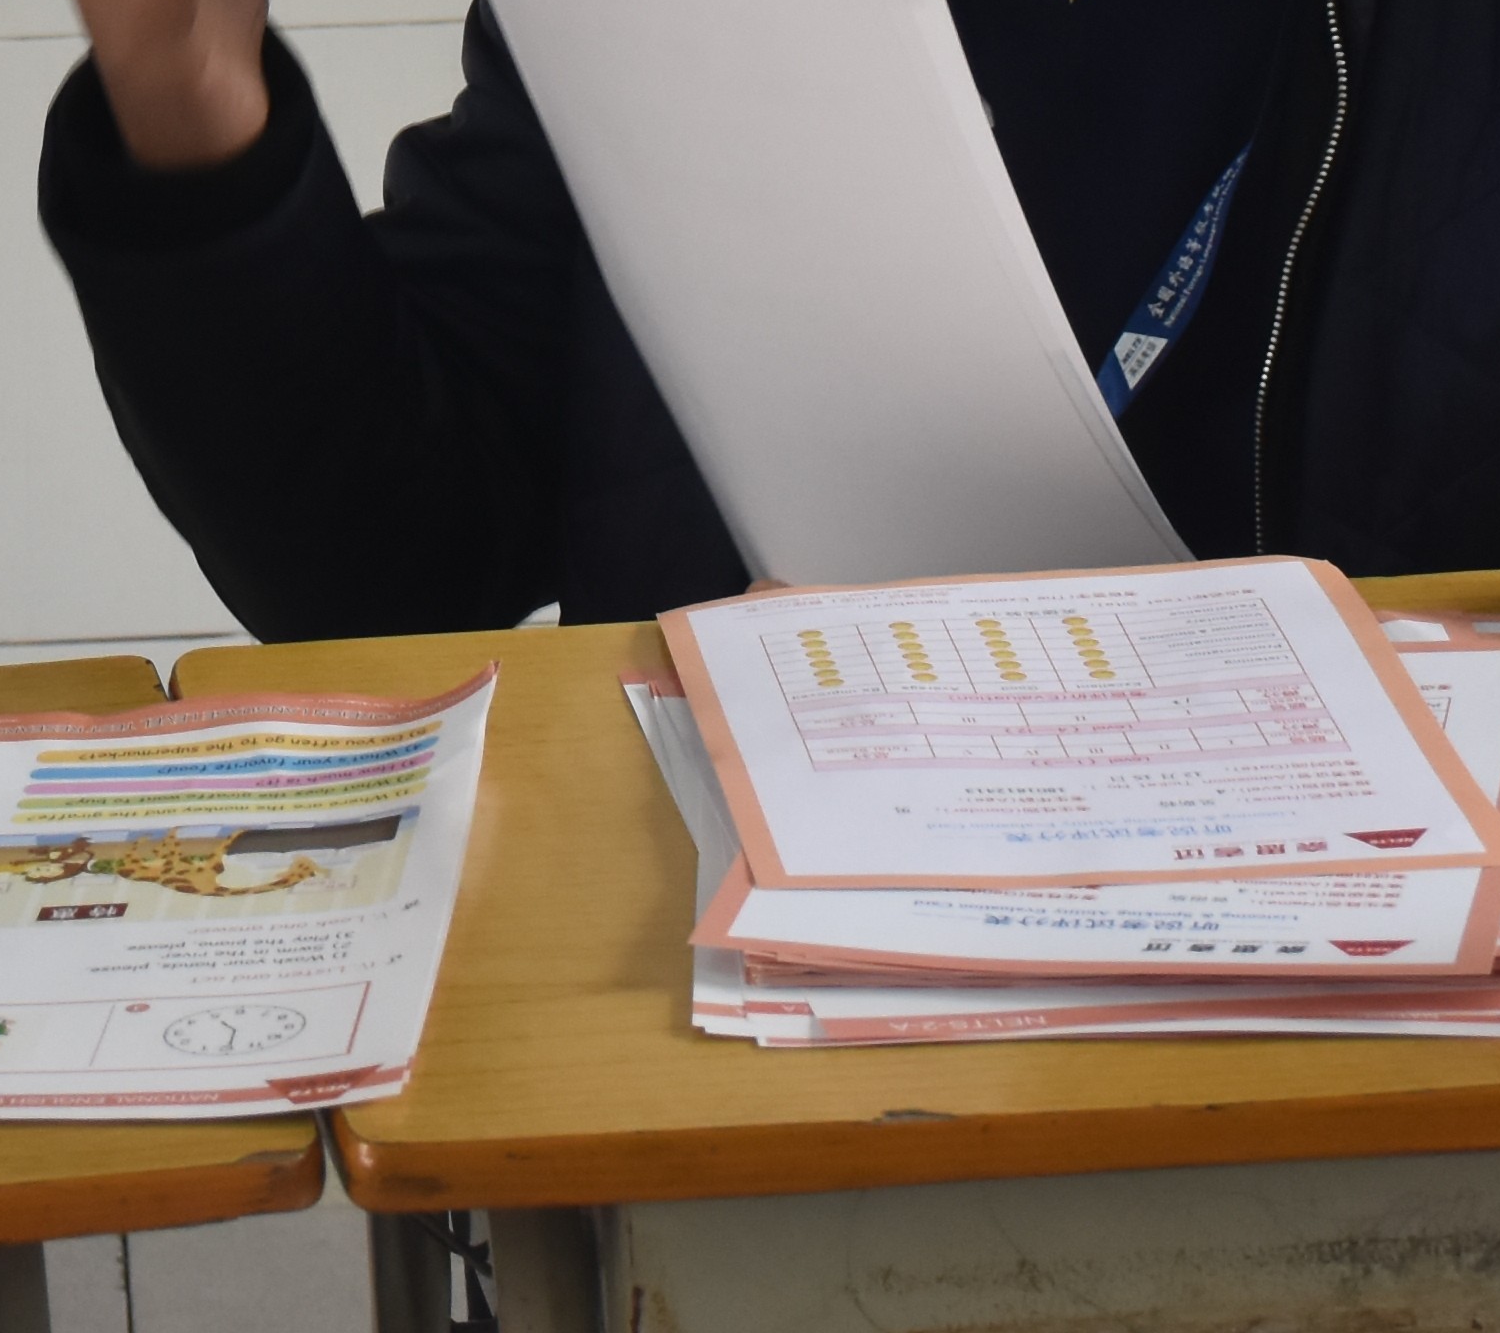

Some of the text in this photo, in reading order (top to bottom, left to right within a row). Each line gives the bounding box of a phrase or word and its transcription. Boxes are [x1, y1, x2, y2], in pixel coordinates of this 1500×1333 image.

[1223, 655, 1290, 665] Listening
[1074, 682, 1143, 690] Excellent
[78, 735, 375, 760] you often go to the supermarket?
[216, 757, 285, 771] favorite
[293, 757, 333, 766] your
[1108, 756, 1150, 764] Level
[157, 764, 207, 774] food?
[65, 797, 107, 806] buy?
[184, 793, 251, 801] giraffe
[144, 809, 177, 817] and
[184, 805, 250, 815] monkey
[256, 805, 284, 813] the
[26, 812, 102, 822] giraffe?
[1006, 824, 1233, 844] 听说考试评分表
[913, 899, 951, 908] Card
[958, 903, 1047, 913] Evaluation
[1052, 908, 1109, 917] Ability
[1118, 909, 1193, 918] Speaking
[981, 914, 1221, 932] 听说考试评分表
[293, 934, 329, 943] Play
[276, 946, 324, 954] Swim
[224, 958, 265, 967] your
[272, 954, 324, 965] Wash
[232, 974, 271, 983] and
[10, 1096, 106, 1106] ENGLISH
[115, 1094, 220, 1104] NATIONAL
